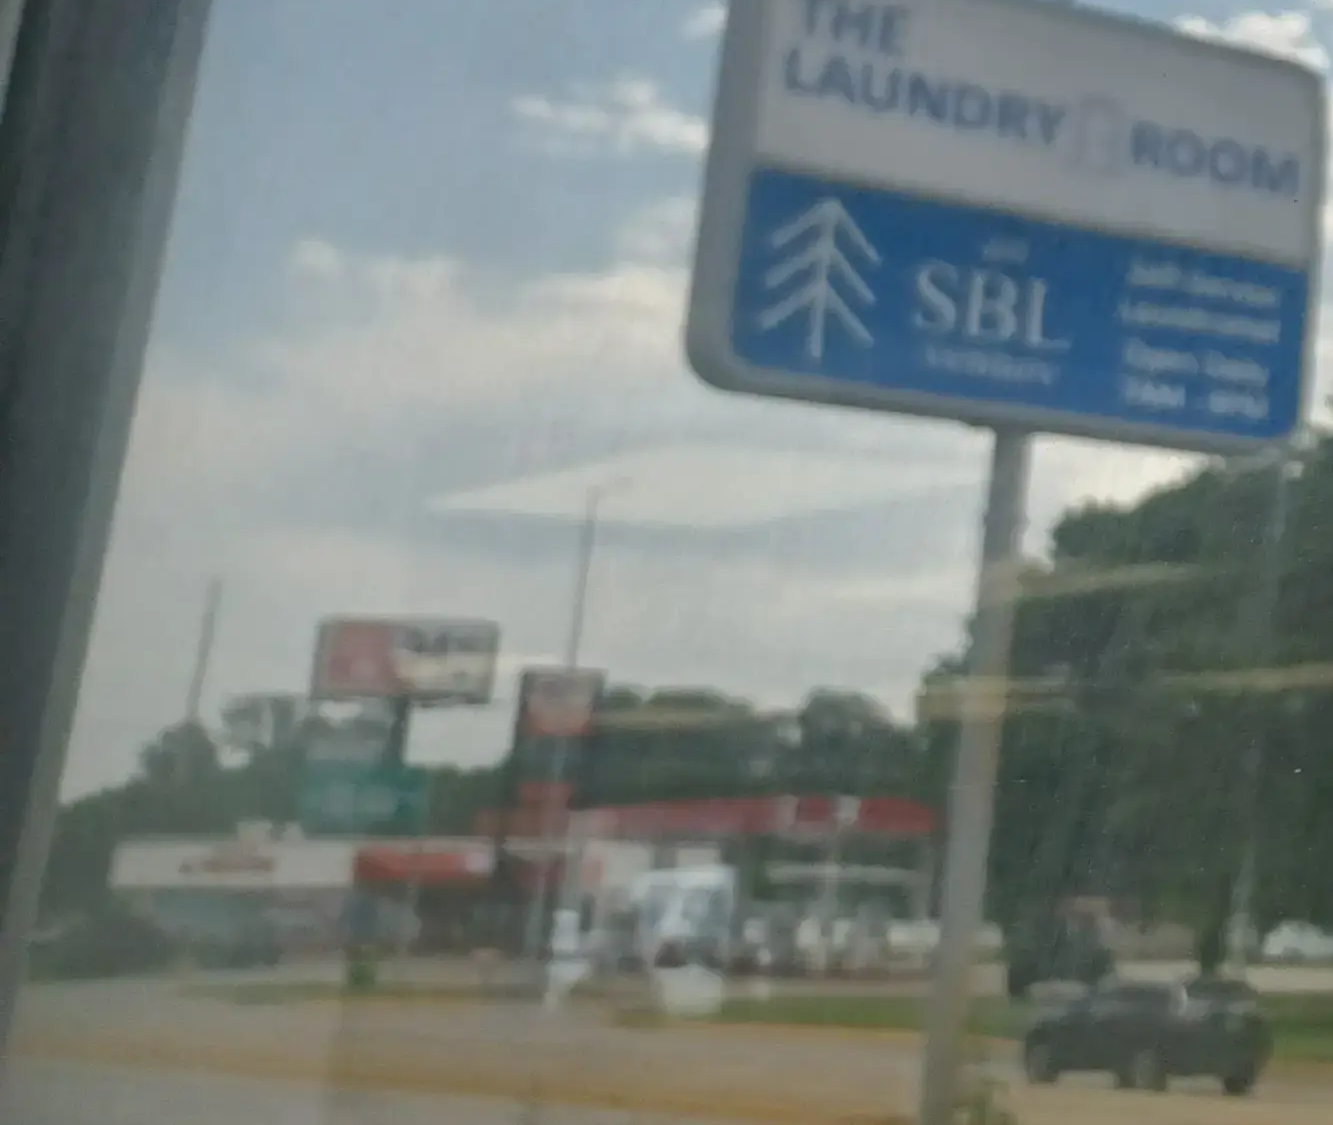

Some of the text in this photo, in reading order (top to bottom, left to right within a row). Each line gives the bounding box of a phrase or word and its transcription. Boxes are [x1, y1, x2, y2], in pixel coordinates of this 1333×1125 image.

[784, 49, 1300, 198] LAUNDRY ROOM
[911, 257, 1072, 351] SBL
